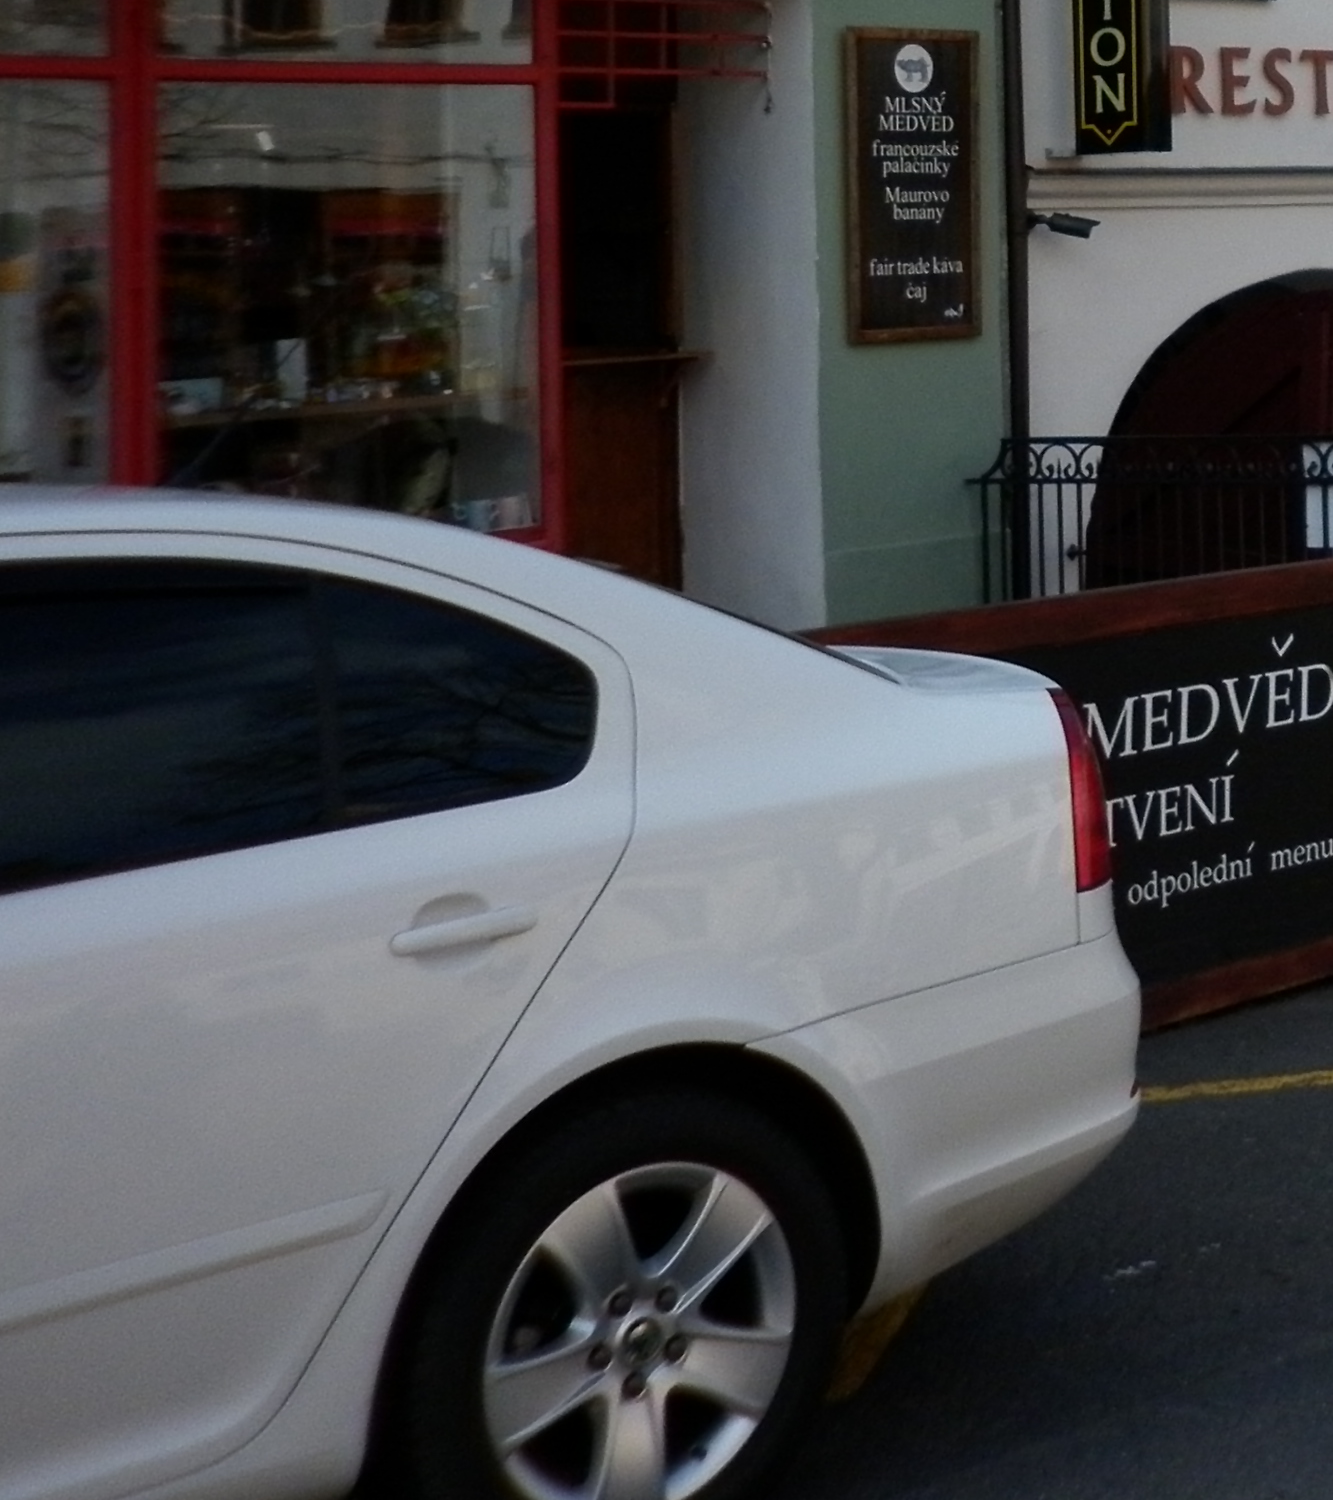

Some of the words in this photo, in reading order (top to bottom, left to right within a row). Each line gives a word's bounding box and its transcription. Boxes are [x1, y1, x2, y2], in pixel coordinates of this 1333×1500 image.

[884, 91, 947, 114] MLSNÝ
[872, 139, 960, 157] francouzské
[882, 157, 951, 178] palačinky
[885, 186, 951, 203] Maurovo
[893, 202, 945, 224] banány
[869, 257, 895, 276] fair
[897, 256, 931, 275] trade
[932, 256, 964, 274] káva
[1127, 840, 1256, 908] odpolední
